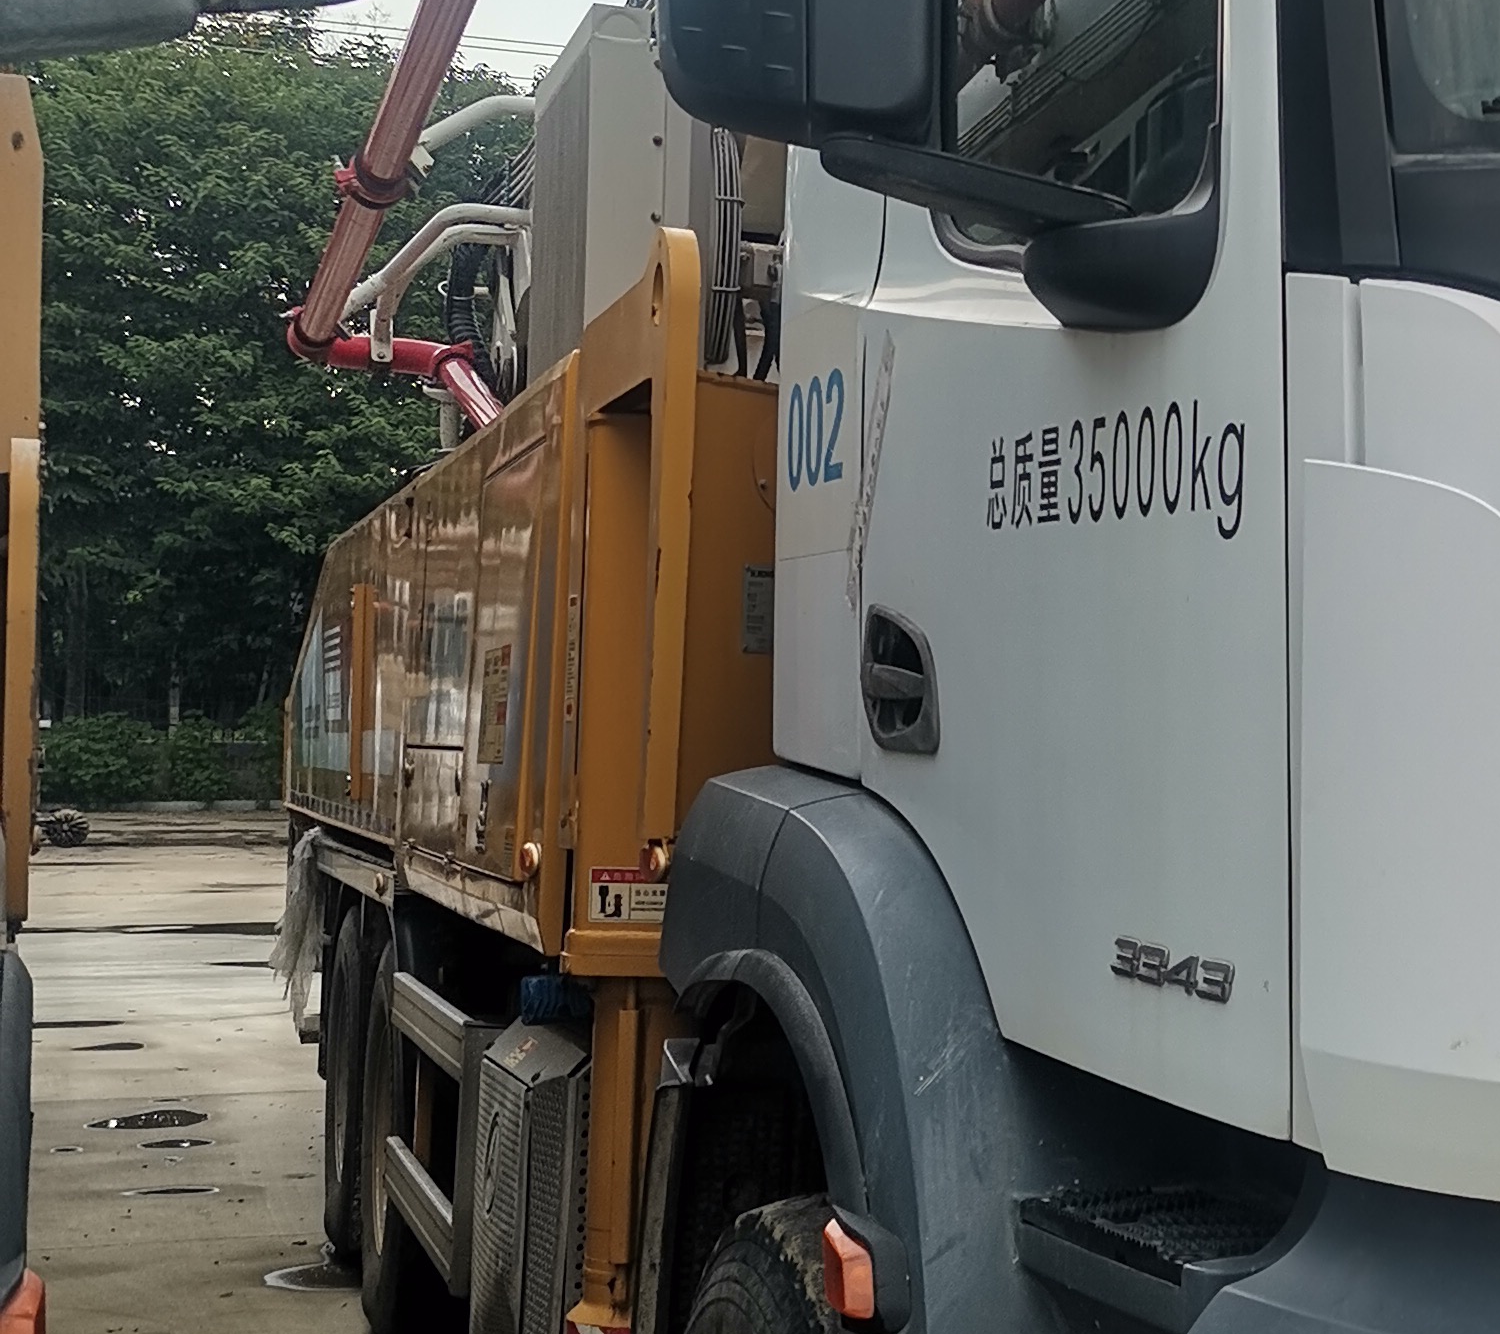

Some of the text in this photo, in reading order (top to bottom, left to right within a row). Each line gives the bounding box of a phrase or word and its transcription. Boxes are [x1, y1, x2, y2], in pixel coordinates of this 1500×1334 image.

[787, 367, 844, 492] 002
[986, 399, 1245, 540] 总质量35000kg
[1109, 934, 1236, 1005] 3343
